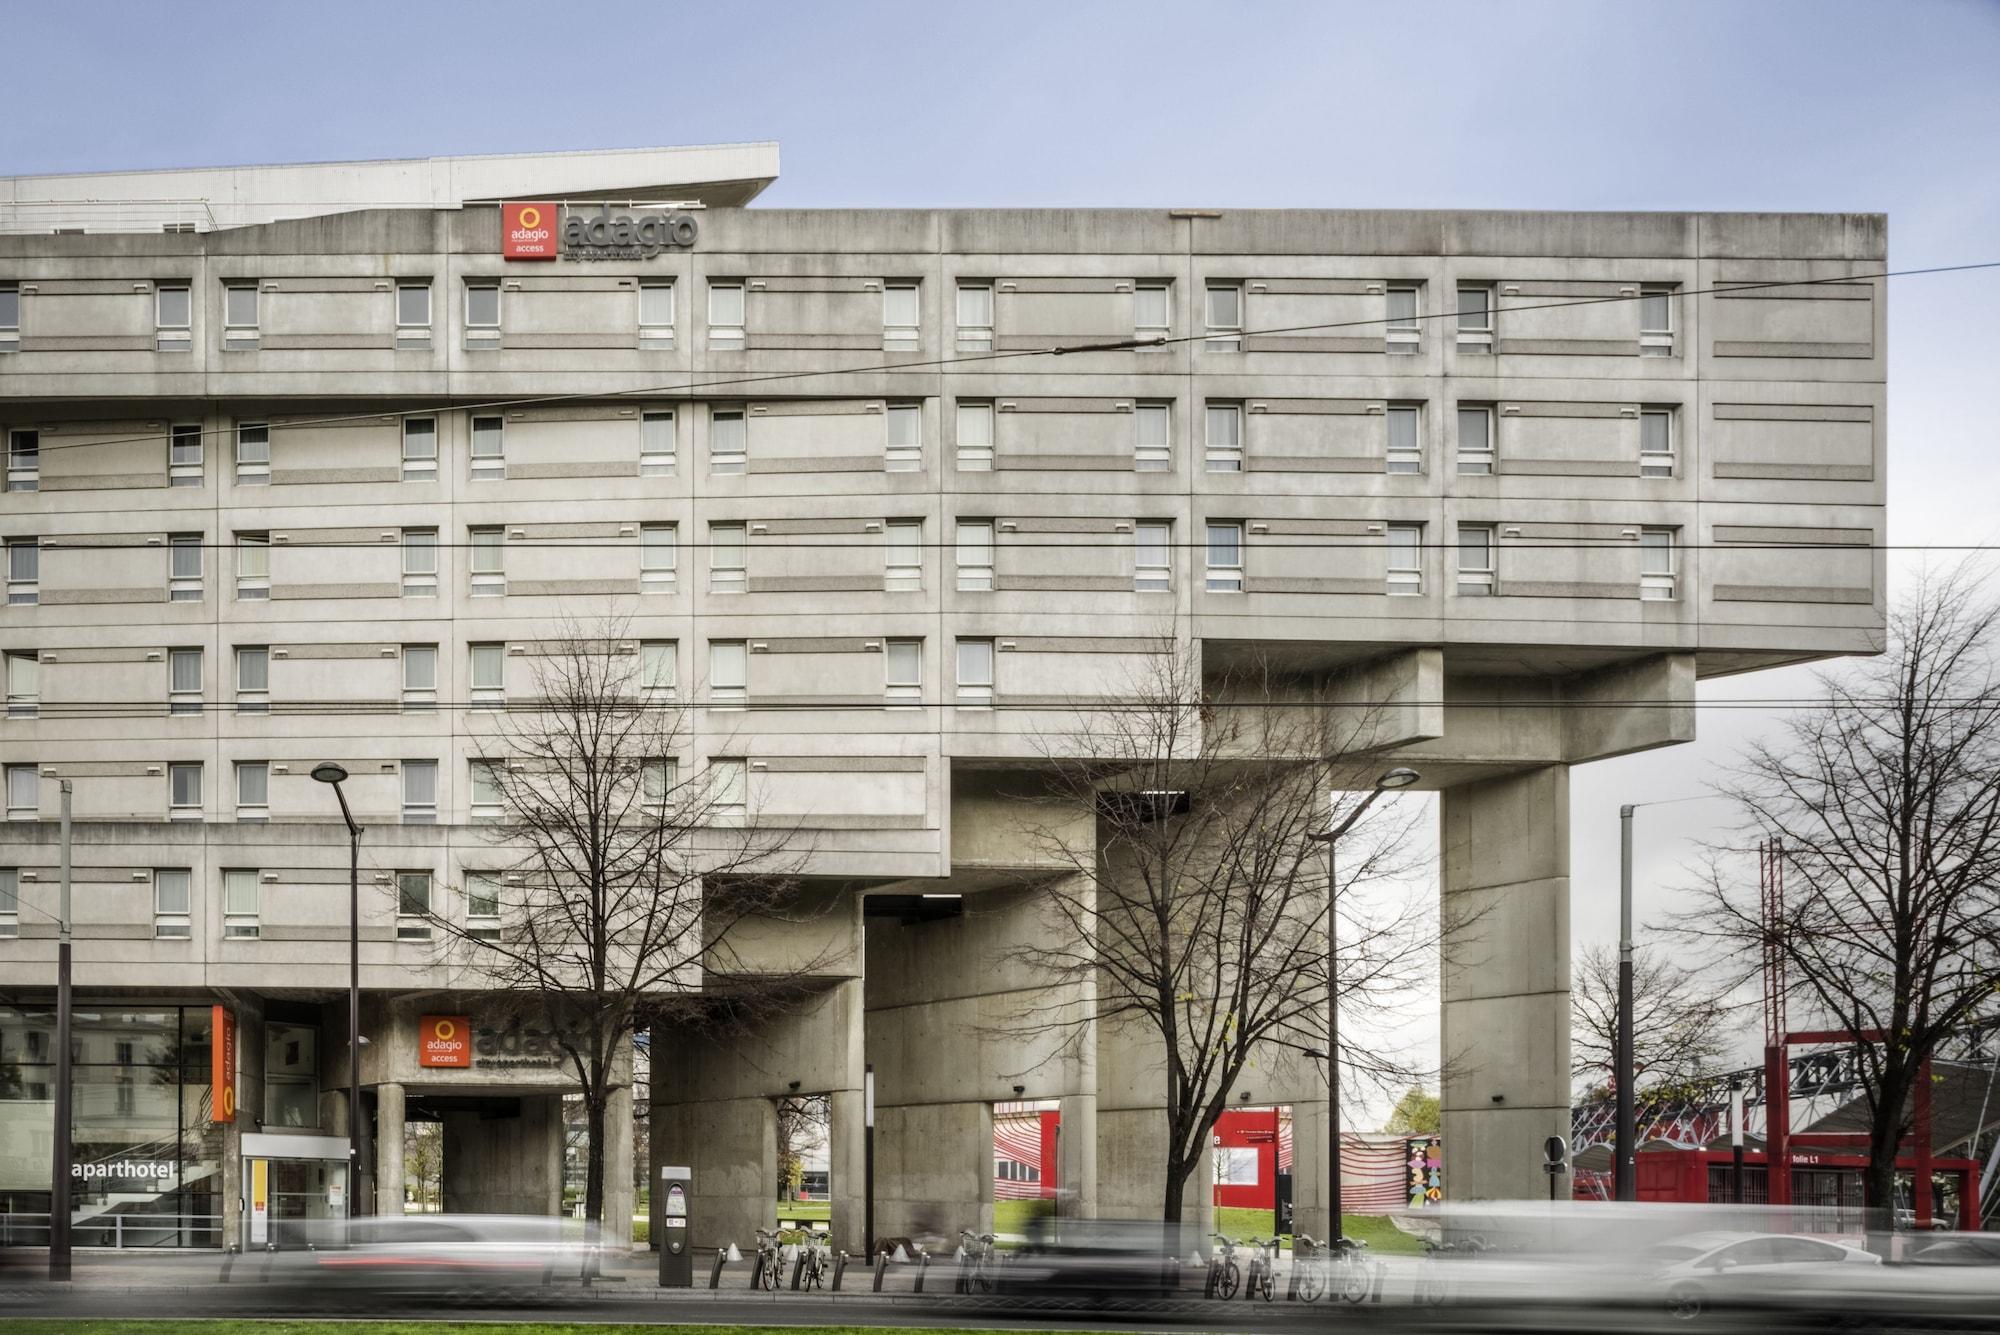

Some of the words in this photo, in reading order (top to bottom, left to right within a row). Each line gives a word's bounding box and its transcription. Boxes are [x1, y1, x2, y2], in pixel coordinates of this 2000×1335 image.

[511, 227, 549, 242] adagio
[564, 203, 698, 258] adagio
[427, 1038, 462, 1052] adagio
[431, 1055, 458, 1063] access
[71, 1160, 174, 1181] aparthotel
